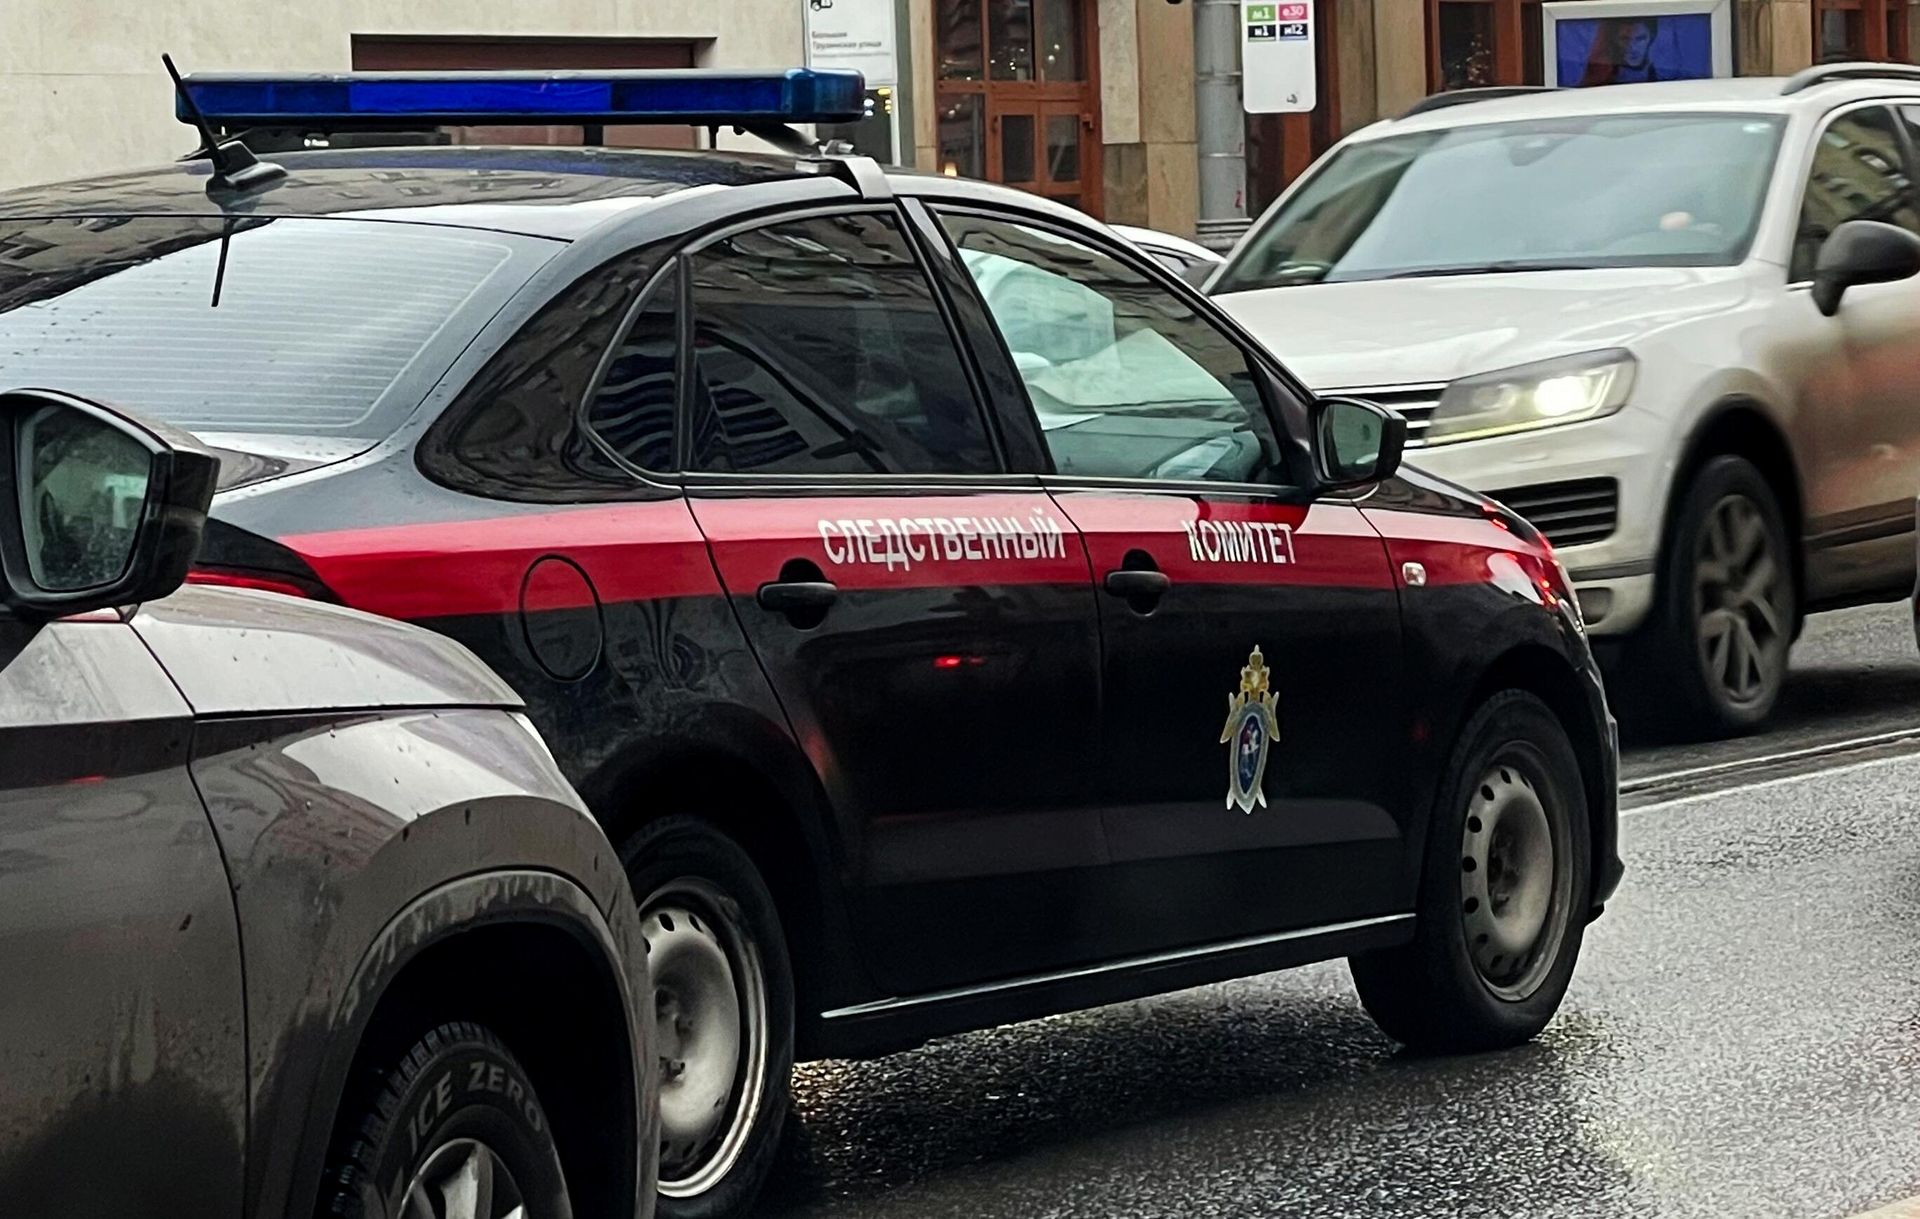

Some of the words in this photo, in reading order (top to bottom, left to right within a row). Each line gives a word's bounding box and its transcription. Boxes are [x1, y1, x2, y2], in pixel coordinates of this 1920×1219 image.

[818, 508, 1066, 572] СЛЕДСТВЕННЫЙ
[1181, 520, 1296, 564] КОМИТЕТ
[408, 1071, 451, 1155] ICE
[467, 1061, 542, 1131] ZERO
